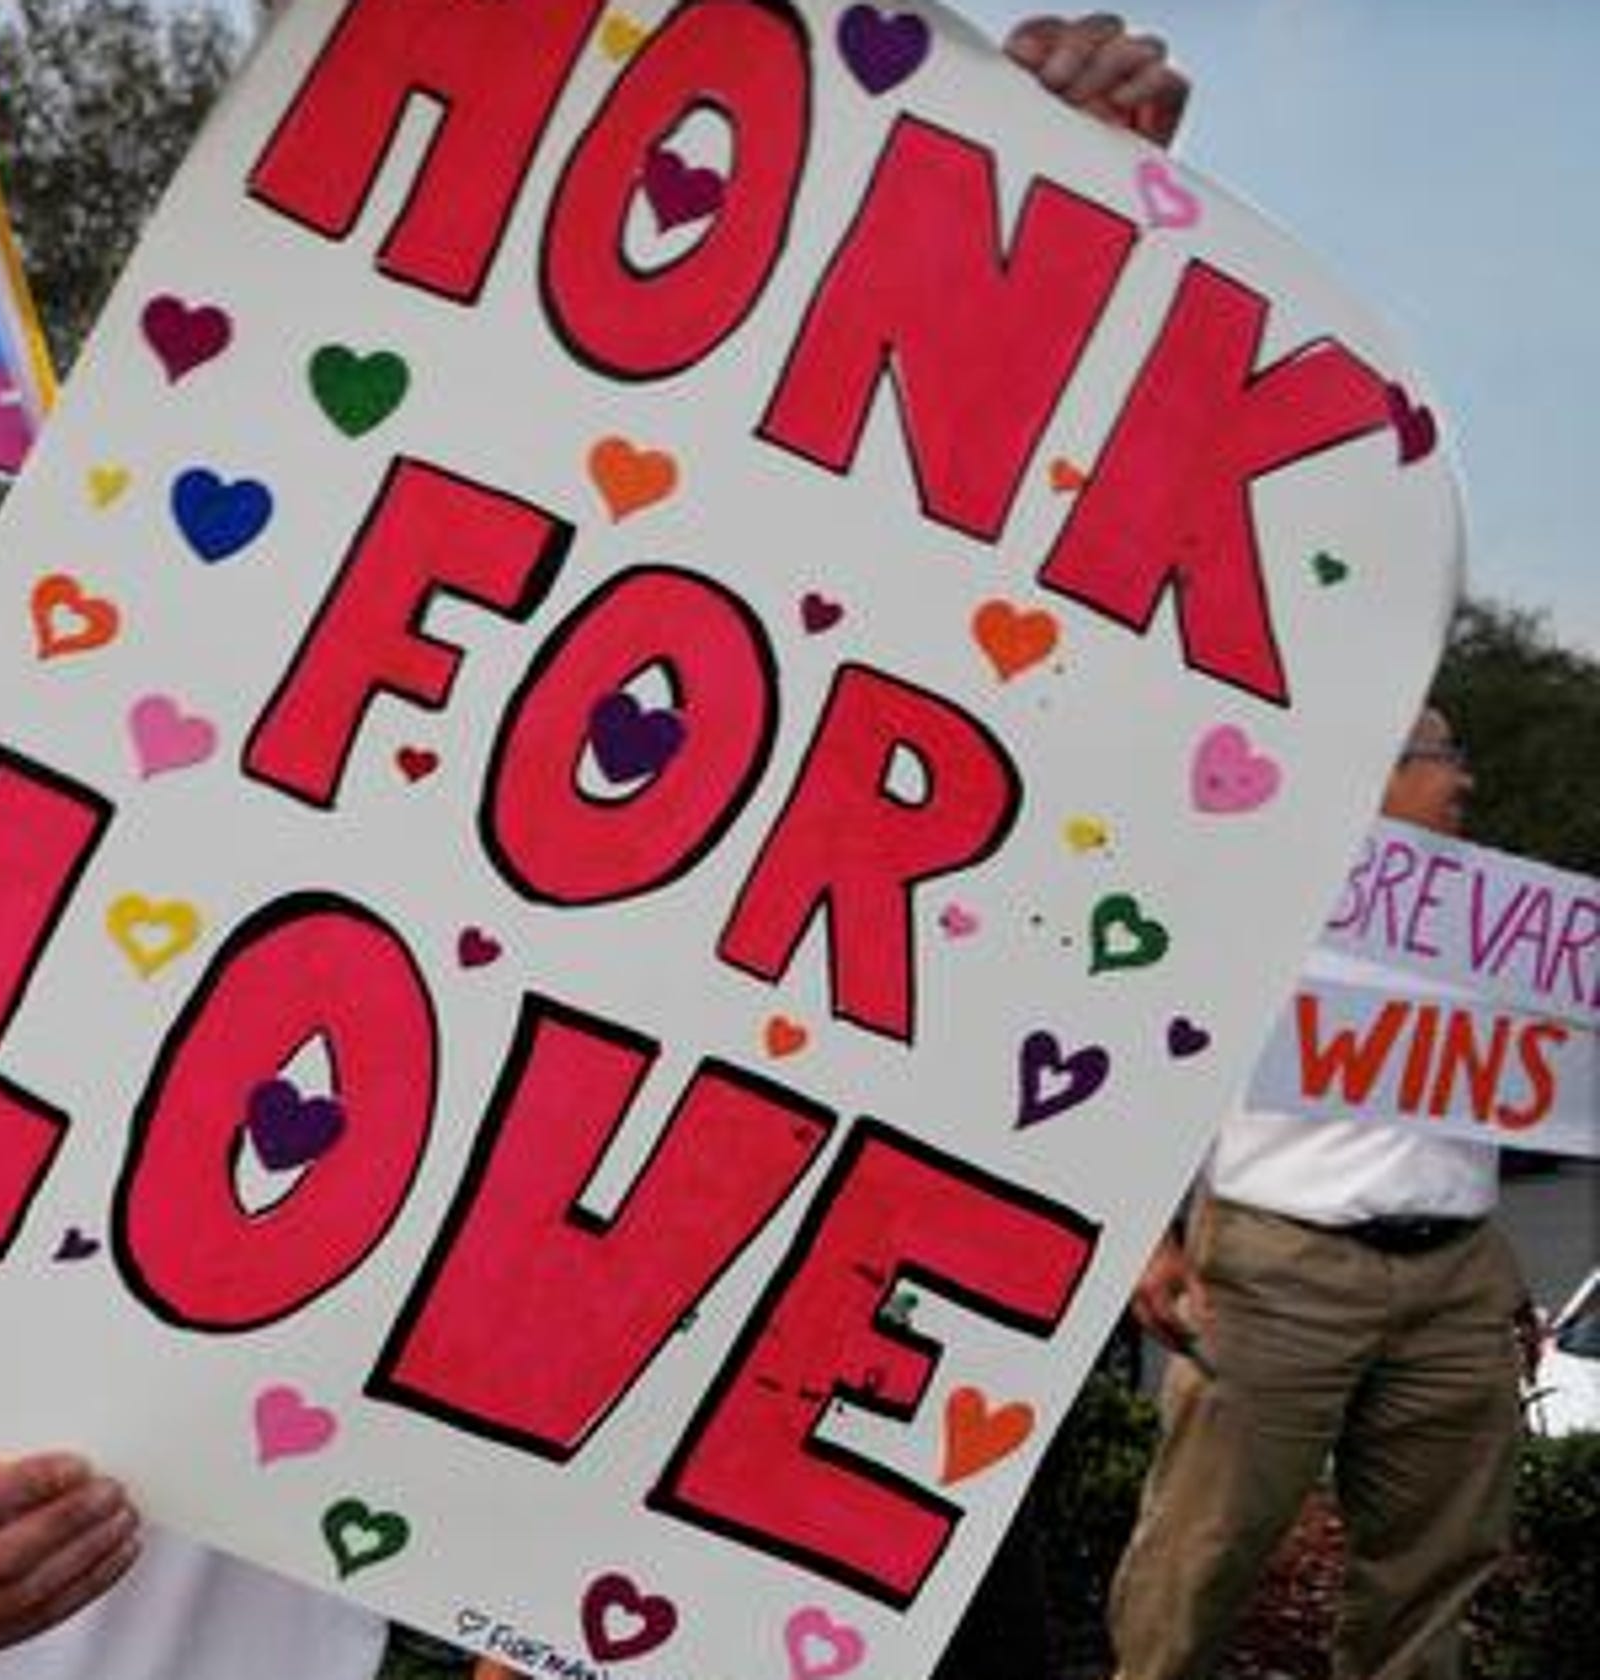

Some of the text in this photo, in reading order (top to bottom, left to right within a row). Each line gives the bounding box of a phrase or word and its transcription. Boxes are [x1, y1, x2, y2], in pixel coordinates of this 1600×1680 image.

[245, 0, 1400, 707] HONK
[240, 457, 1022, 1043] FOR
[1326, 836, 1600, 1008] BREVAR
[1295, 993, 1569, 1131] WINS
